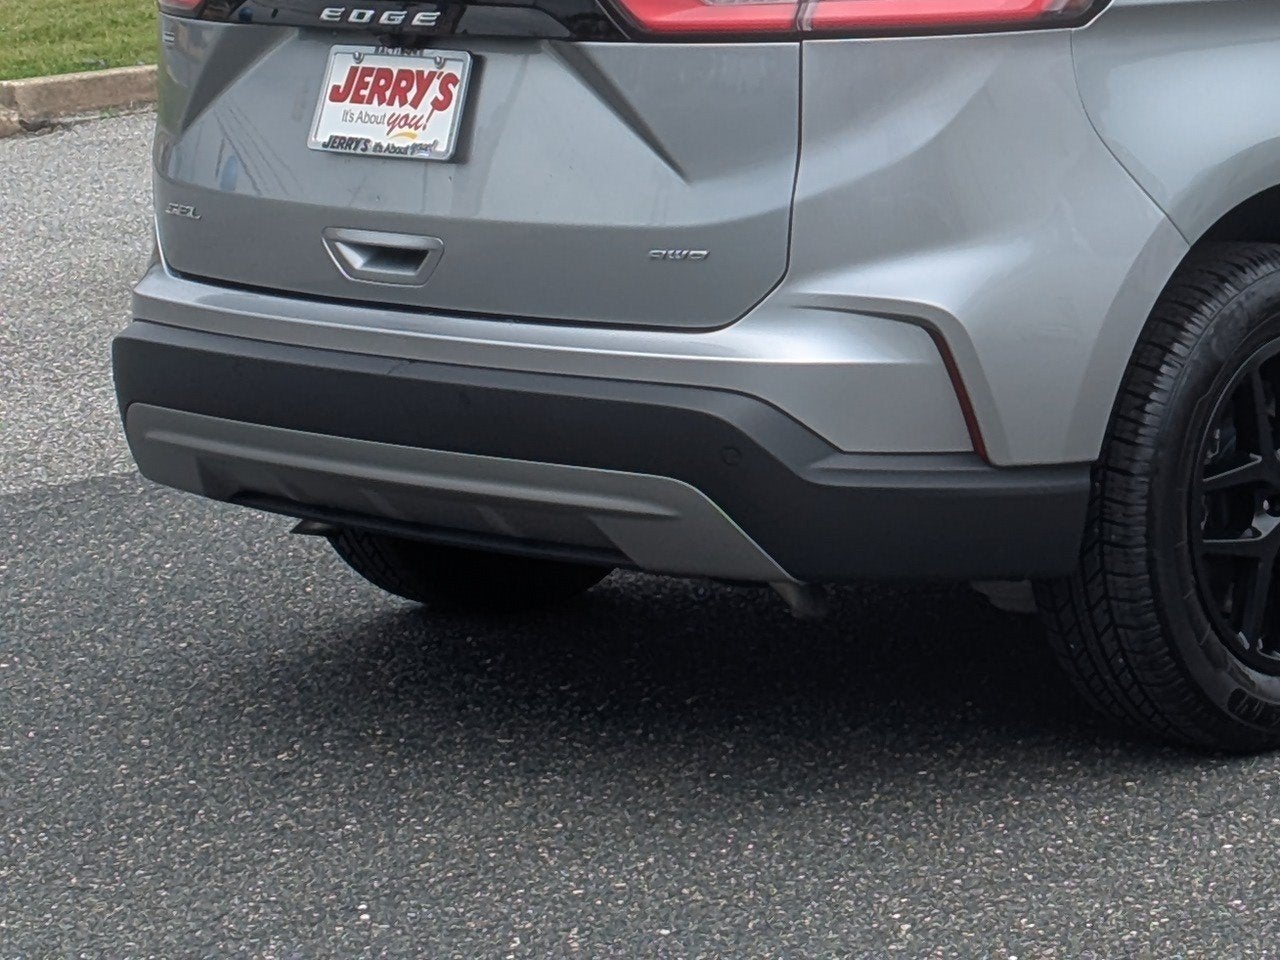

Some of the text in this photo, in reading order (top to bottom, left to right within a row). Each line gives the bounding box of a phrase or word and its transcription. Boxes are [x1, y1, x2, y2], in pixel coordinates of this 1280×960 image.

[318, 6, 441, 27] EDGE
[328, 65, 461, 112] JERRY'S
[341, 106, 436, 136] It's About you!
[321, 134, 372, 152] JERRY'S
[384, 143, 409, 155] About
